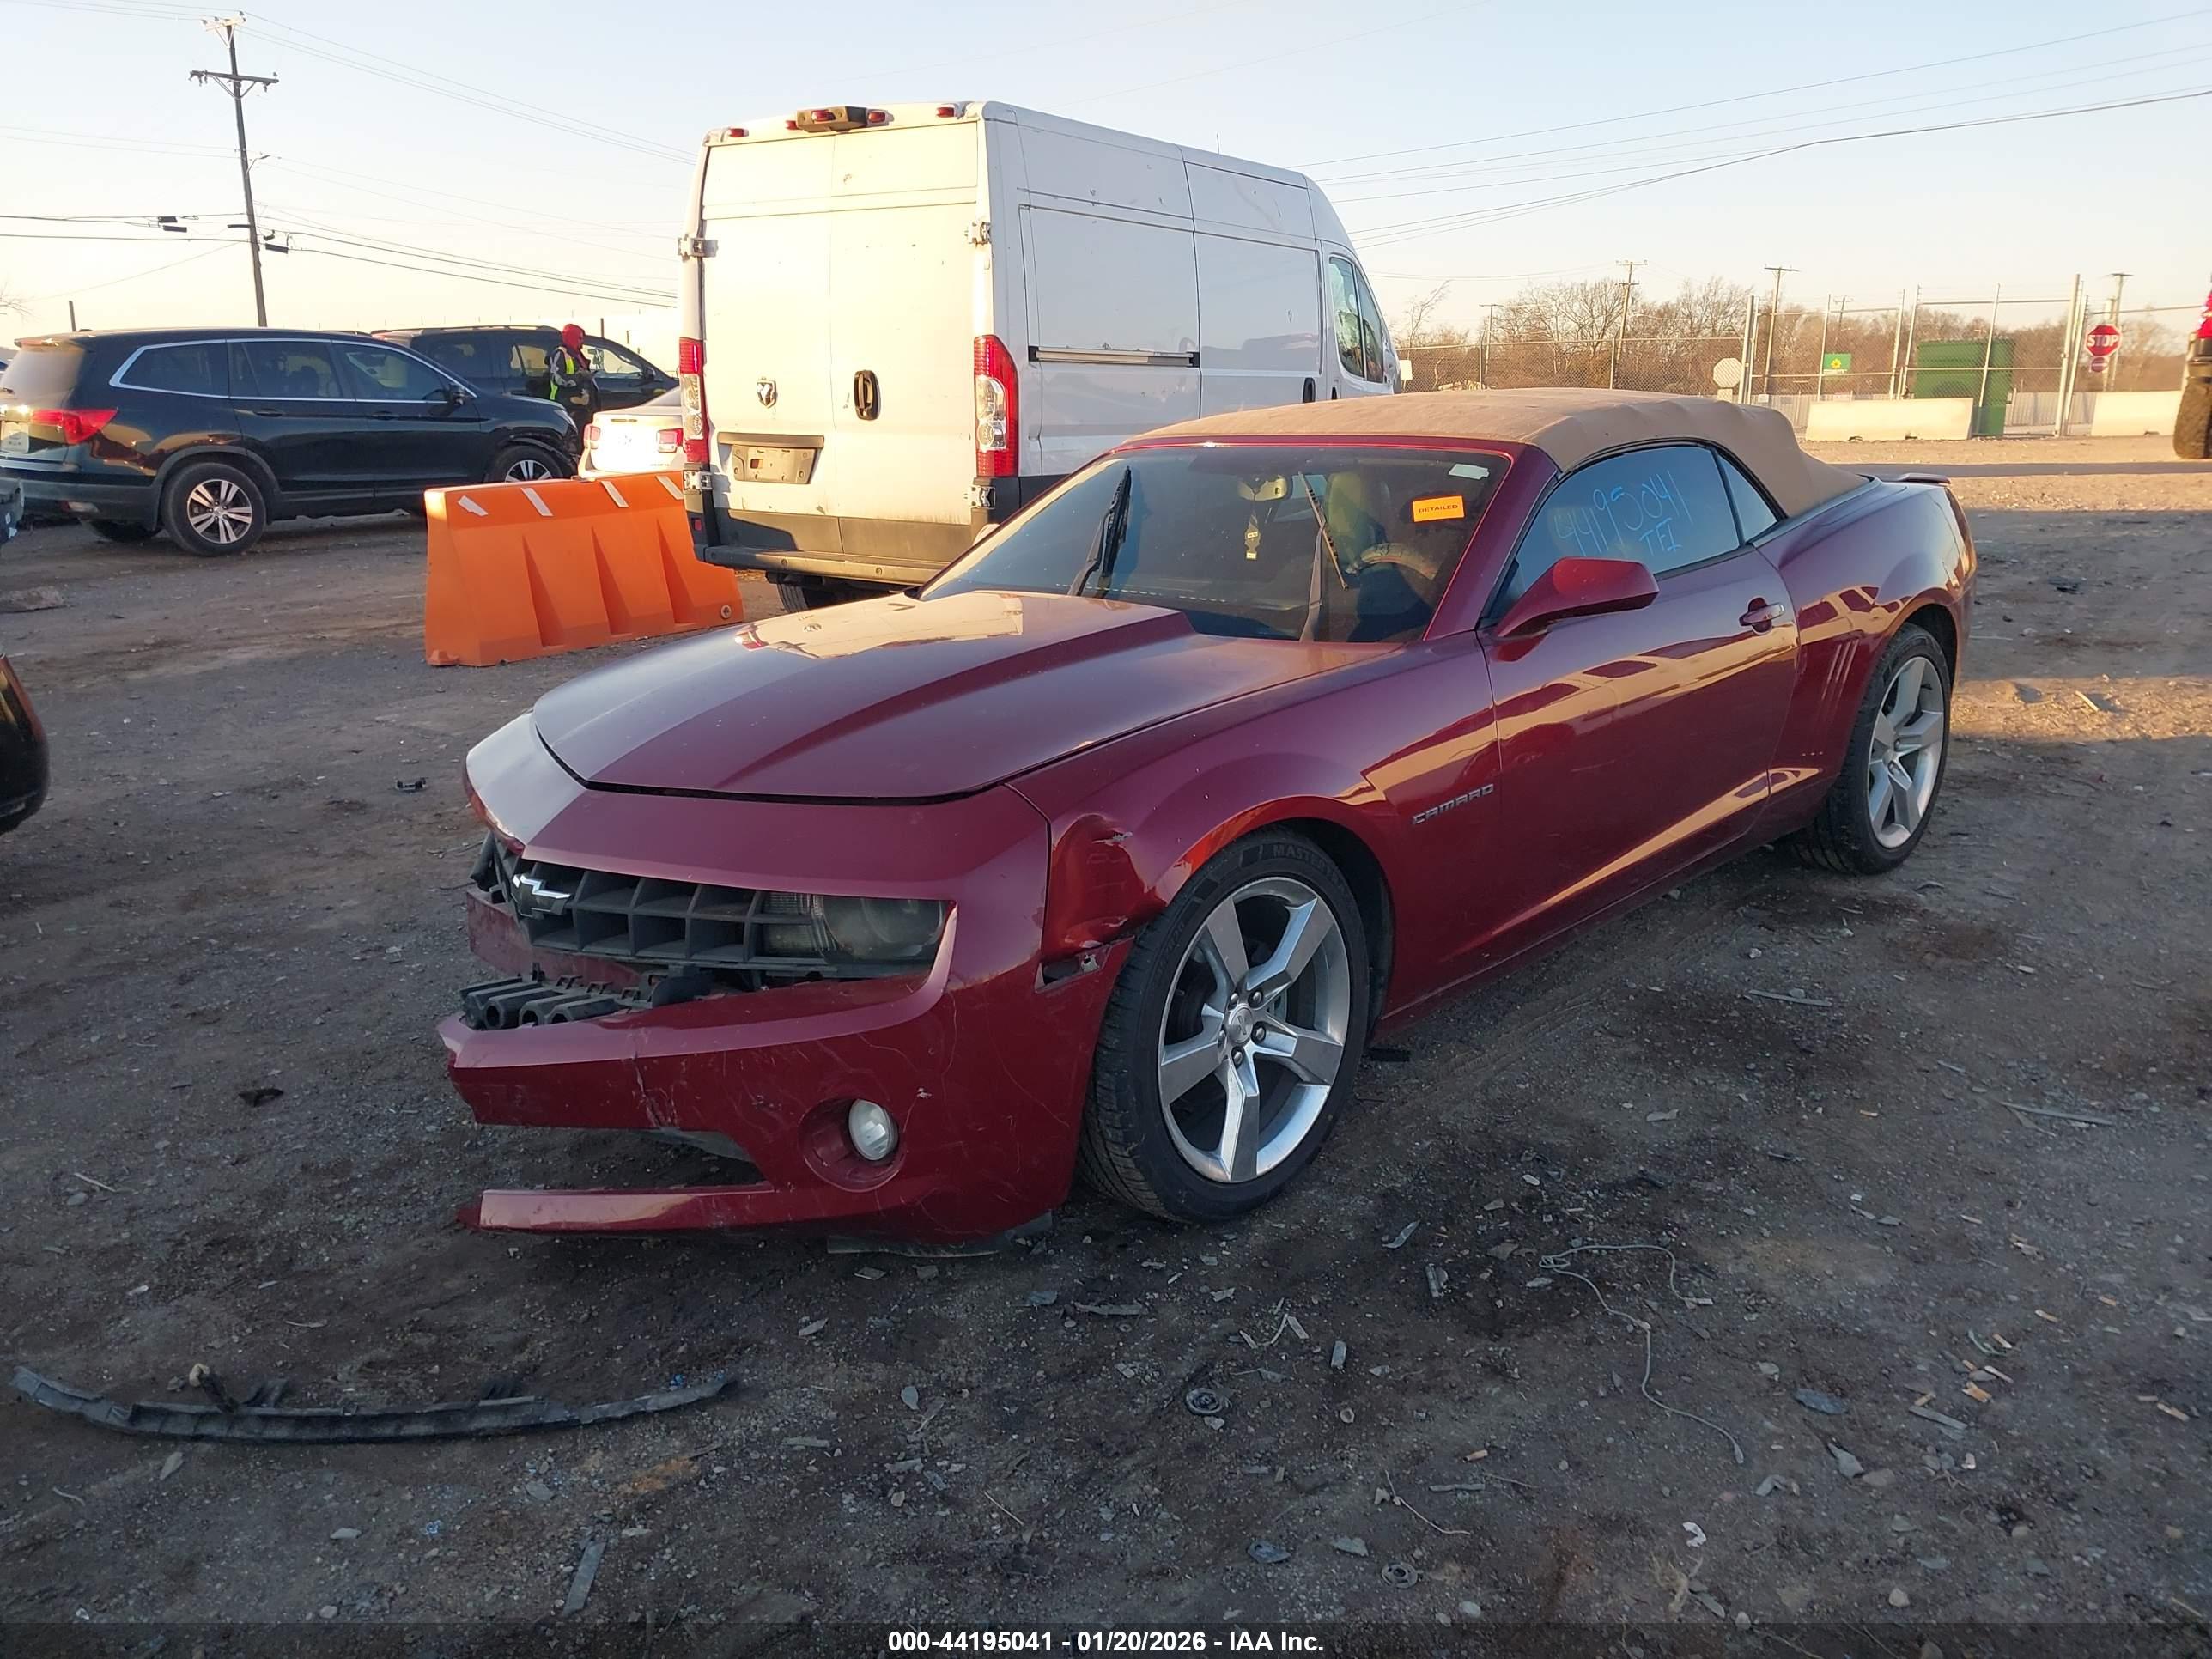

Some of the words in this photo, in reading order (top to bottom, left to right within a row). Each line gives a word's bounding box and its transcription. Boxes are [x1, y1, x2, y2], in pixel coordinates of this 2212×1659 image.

[2087, 334, 2118, 347] STOP
[1418, 503, 1459, 514] DETAILED
[1412, 783, 1494, 825] CAMARO
